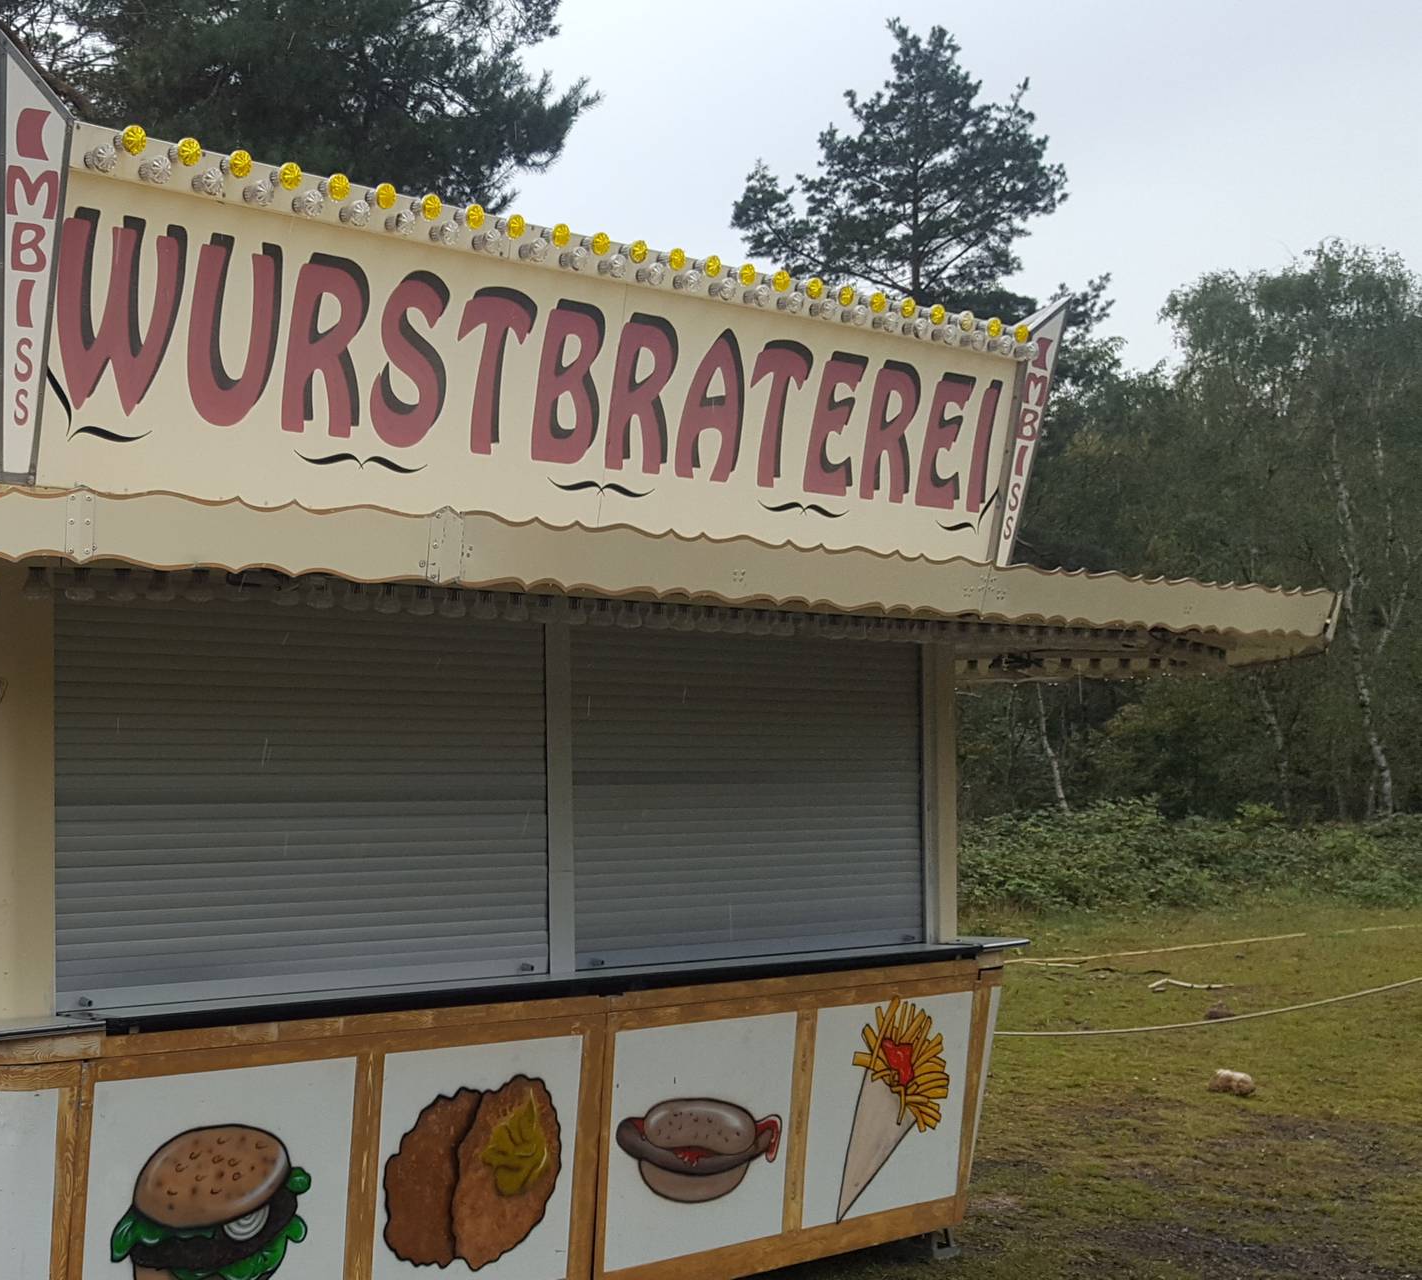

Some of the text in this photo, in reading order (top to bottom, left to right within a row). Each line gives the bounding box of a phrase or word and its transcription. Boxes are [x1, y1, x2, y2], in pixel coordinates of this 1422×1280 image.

[8, 108, 58, 426] IMBISS
[57, 206, 1003, 513] WURSTBRATEREI
[1003, 337, 1053, 540] IMBISS
